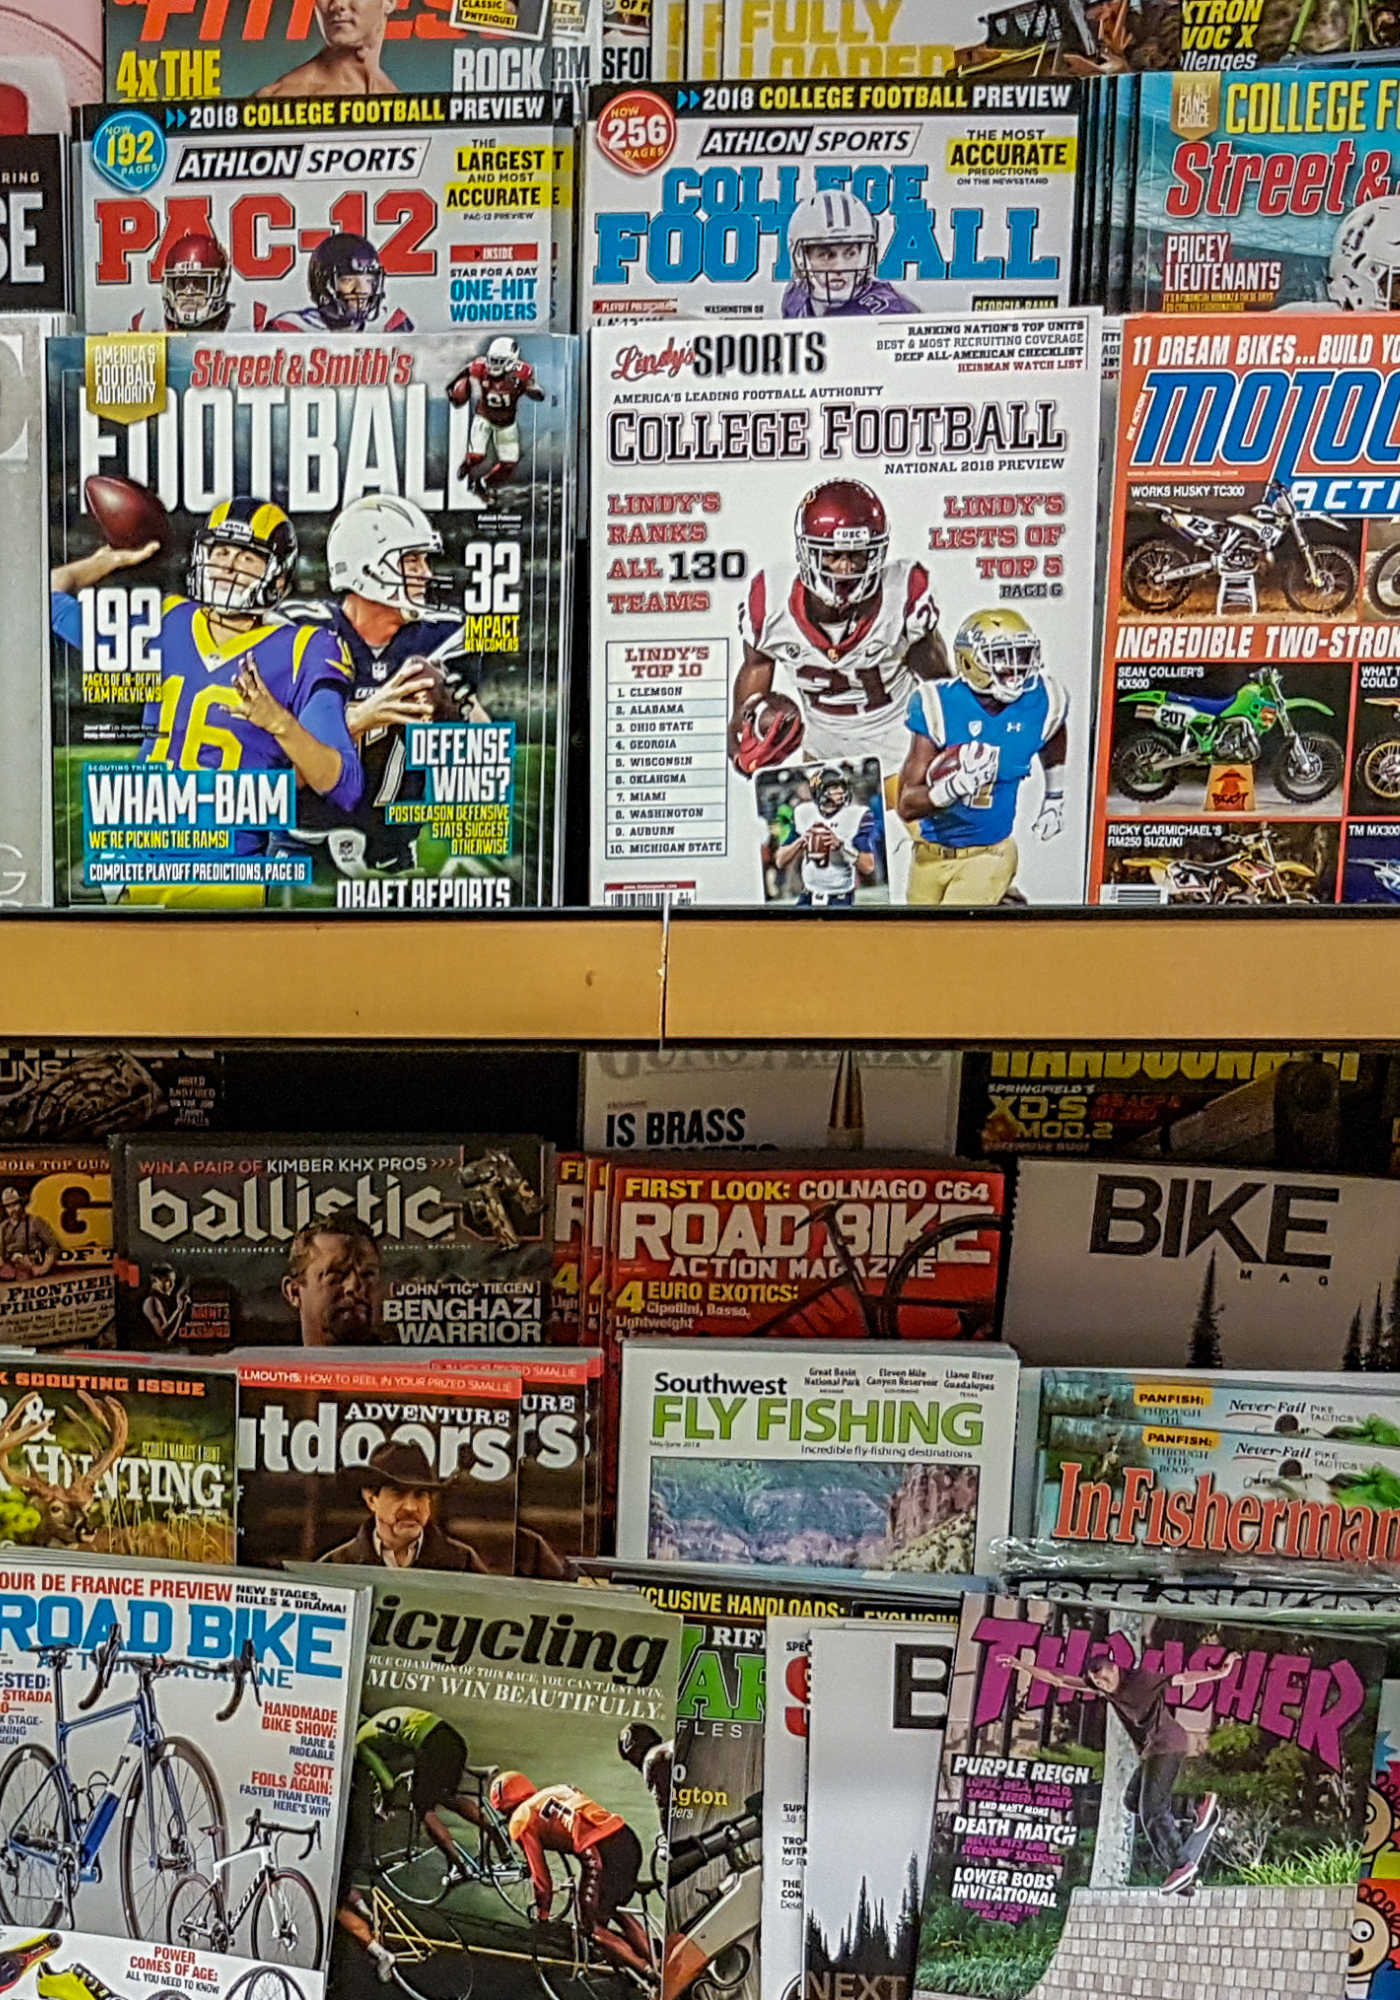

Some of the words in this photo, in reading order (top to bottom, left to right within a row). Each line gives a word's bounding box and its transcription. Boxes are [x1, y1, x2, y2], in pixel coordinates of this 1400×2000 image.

[464, 11, 514, 25] PHYSIQUE!
[703, 90, 754, 111] 2018
[760, 89, 854, 110] COLLEGE
[859, 87, 967, 108] FOOTBALL
[973, 85, 1071, 106] PREVIEW
[190, 108, 238, 128] 2018
[243, 104, 335, 125] COLLEGE
[340, 101, 444, 123] FOOTBALL
[450, 98, 544, 120] PREVIEW
[610, 106, 639, 117] NOW
[472, 139, 496, 148] THE
[607, 115, 667, 150] 256
[703, 128, 810, 154] ATHLON
[815, 129, 911, 152] SPORTS
[967, 130, 997, 140] THE
[1002, 130, 1045, 140] MOST
[106, 130, 154, 165] 192
[624, 146, 664, 161] PAGES
[951, 144, 1067, 165] ACCURATE
[179, 146, 297, 177] ATHLON
[306, 144, 418, 173] SPORTS
[457, 151, 544, 171] LARGEST
[468, 173, 494, 183] AND
[499, 173, 534, 182] MOST
[446, 187, 541, 207] ACCURATE
[95, 190, 438, 285] PAC-12
[1167, 234, 1229, 262] PRICEY
[1165, 262, 1282, 292] LIEUTENANTS
[450, 278, 537, 301] ONE-HIT
[450, 303, 537, 322] WONDERS
[693, 331, 827, 379] SPORTS
[94, 364, 157, 387] FOOTBALL
[190, 349, 287, 387] Street
[287, 354, 307, 385] &
[307, 347, 412, 387] Smith's
[95, 385, 157, 405] AUTHORITY
[613, 394, 682, 404] AMERICA'S
[685, 391, 739, 403] LEADING
[743, 388, 806, 401] FOOTBALL
[809, 385, 884, 398] AUTHORITY
[608, 409, 809, 466] COLLEGE
[821, 401, 1068, 459] FOOTBALL
[884, 462, 957, 475] NATIONAL
[961, 460, 994, 472] 2018
[998, 458, 1065, 471] PREVIEW
[1131, 486, 1170, 497] WORKS
[1173, 486, 1210, 496] HUSKY
[607, 493, 721, 514] LINDY'S
[944, 495, 1065, 517] LINDY'S
[607, 522, 706, 545] RANKS
[929, 527, 1017, 550] LISTS
[1024, 524, 1065, 547] OF
[465, 542, 521, 613] 32
[976, 557, 1037, 580] TOP
[1043, 555, 1064, 577] 5
[608, 592, 710, 614] TEAMS
[77, 587, 162, 673] 192
[465, 615, 519, 638] IMPACT
[624, 647, 710, 663] LINDY'S
[631, 665, 674, 679] TOP
[678, 663, 703, 677] 10
[1118, 667, 1146, 678] SEAN
[1148, 667, 1204, 678] COLLIER'S
[1361, 666, 1392, 677] WHAT
[630, 686, 683, 697] CLEMSON
[1117, 679, 1149, 689] KX500
[1361, 678, 1398, 688] COULD
[82, 687, 110, 703] TEAM
[112, 686, 162, 702] PREVIEWS
[412, 728, 511, 765] DEFENSE
[433, 766, 510, 802] WINS?
[88, 774, 288, 825] WHAM-BAM
[389, 806, 454, 822] POSTSEASON
[456, 805, 509, 821] DEFENSIVE
[432, 823, 463, 839] STATS
[466, 822, 509, 838] SUGGEST
[1108, 826, 1140, 836] RICKY
[1143, 826, 1222, 836] CARMICHAEL'S
[452, 839, 508, 854] OTHERWISE
[630, 842, 685, 853] MICHIGAN
[688, 841, 722, 852] STATE
[988, 1084, 1095, 1094] SPRINGFIELD'S
[139, 1161, 174, 1174] WIN
[176, 1161, 189, 1174] A
[194, 1161, 233, 1173] PAIR
[238, 1160, 262, 1173] OF
[267, 1159, 334, 1173] KIMBER
[339, 1159, 374, 1172] KHX
[379, 1158, 427, 1171] PROS
[625, 1178, 703, 1198] FIRST
[712, 1180, 790, 1200] LOOK:
[799, 1179, 928, 1200] COLNAGO
[935, 1182, 989, 1202] C64
[138, 1175, 454, 1243] ballistic
[1089, 1173, 1340, 1270] BIKE
[617, 1203, 810, 1260] ROAD
[823, 1202, 995, 1264] BIKE
[9, 1276, 111, 1301] FRONTIER
[615, 1280, 645, 1314] 4
[647, 1281, 701, 1300] EURO
[708, 1283, 799, 1303] EXOTICS:
[384, 1299, 541, 1322] BENGHAZI
[396, 1322, 541, 1345] WARRIOR
[615, 1315, 694, 1331] Lightweight
[804, 1377, 842, 1386] National
[844, 1377, 861, 1386] Park
[809, 1367, 832, 1376] Great
[834, 1368, 856, 1377] Basin
[866, 1377, 897, 1387] Canyon
[900, 1378, 938, 1387] Reservoir
[16, 1373, 129, 1392] SCOUTING
[138, 1379, 205, 1396] ISSUE
[654, 1373, 787, 1396] Southwest
[1139, 1394, 1204, 1405] PANFISH:
[344, 1403, 510, 1427] ADVENTURE
[652, 1395, 748, 1440] FLY
[757, 1396, 983, 1445] FISHING
[1148, 1434, 1212, 1446] PANFISH:
[801, 1445, 852, 1456] Incredible
[854, 1446, 905, 1458] fly-fishing
[908, 1448, 972, 1458] destinations
[236, 1585, 266, 1595] NEW
[270, 1588, 321, 1600] STAGES,
[370, 1594, 669, 1688] icycling
[3, 1689, 52, 1703] STRADA
[367, 1669, 434, 1692] MUST
[441, 1677, 489, 1700] WIN
[493, 1683, 661, 1720] BEAUTIFULLY.
[264, 1701, 337, 1723] HANDMADE
[262, 1716, 292, 1732] BIKE
[296, 1721, 336, 1739] SHOW:
[289, 1746, 334, 1760] RIDEABLE
[301, 1736, 326, 1748] RARE
[328, 1740, 335, 1749] &
[294, 1762, 334, 1780] SCOTT
[953, 1756, 1028, 1779] PURPLE
[1031, 1762, 1090, 1784] REIGN
[954, 1867, 1008, 1885] LOWER
[1011, 1872, 1055, 1889] BOBS
[952, 1883, 1057, 1907] INVITATIONAL
[154, 1947, 196, 1965] POWER
[130, 1956, 175, 1974] COMES
[177, 1963, 191, 1977] OF
[193, 1966, 218, 1982] AGE:
